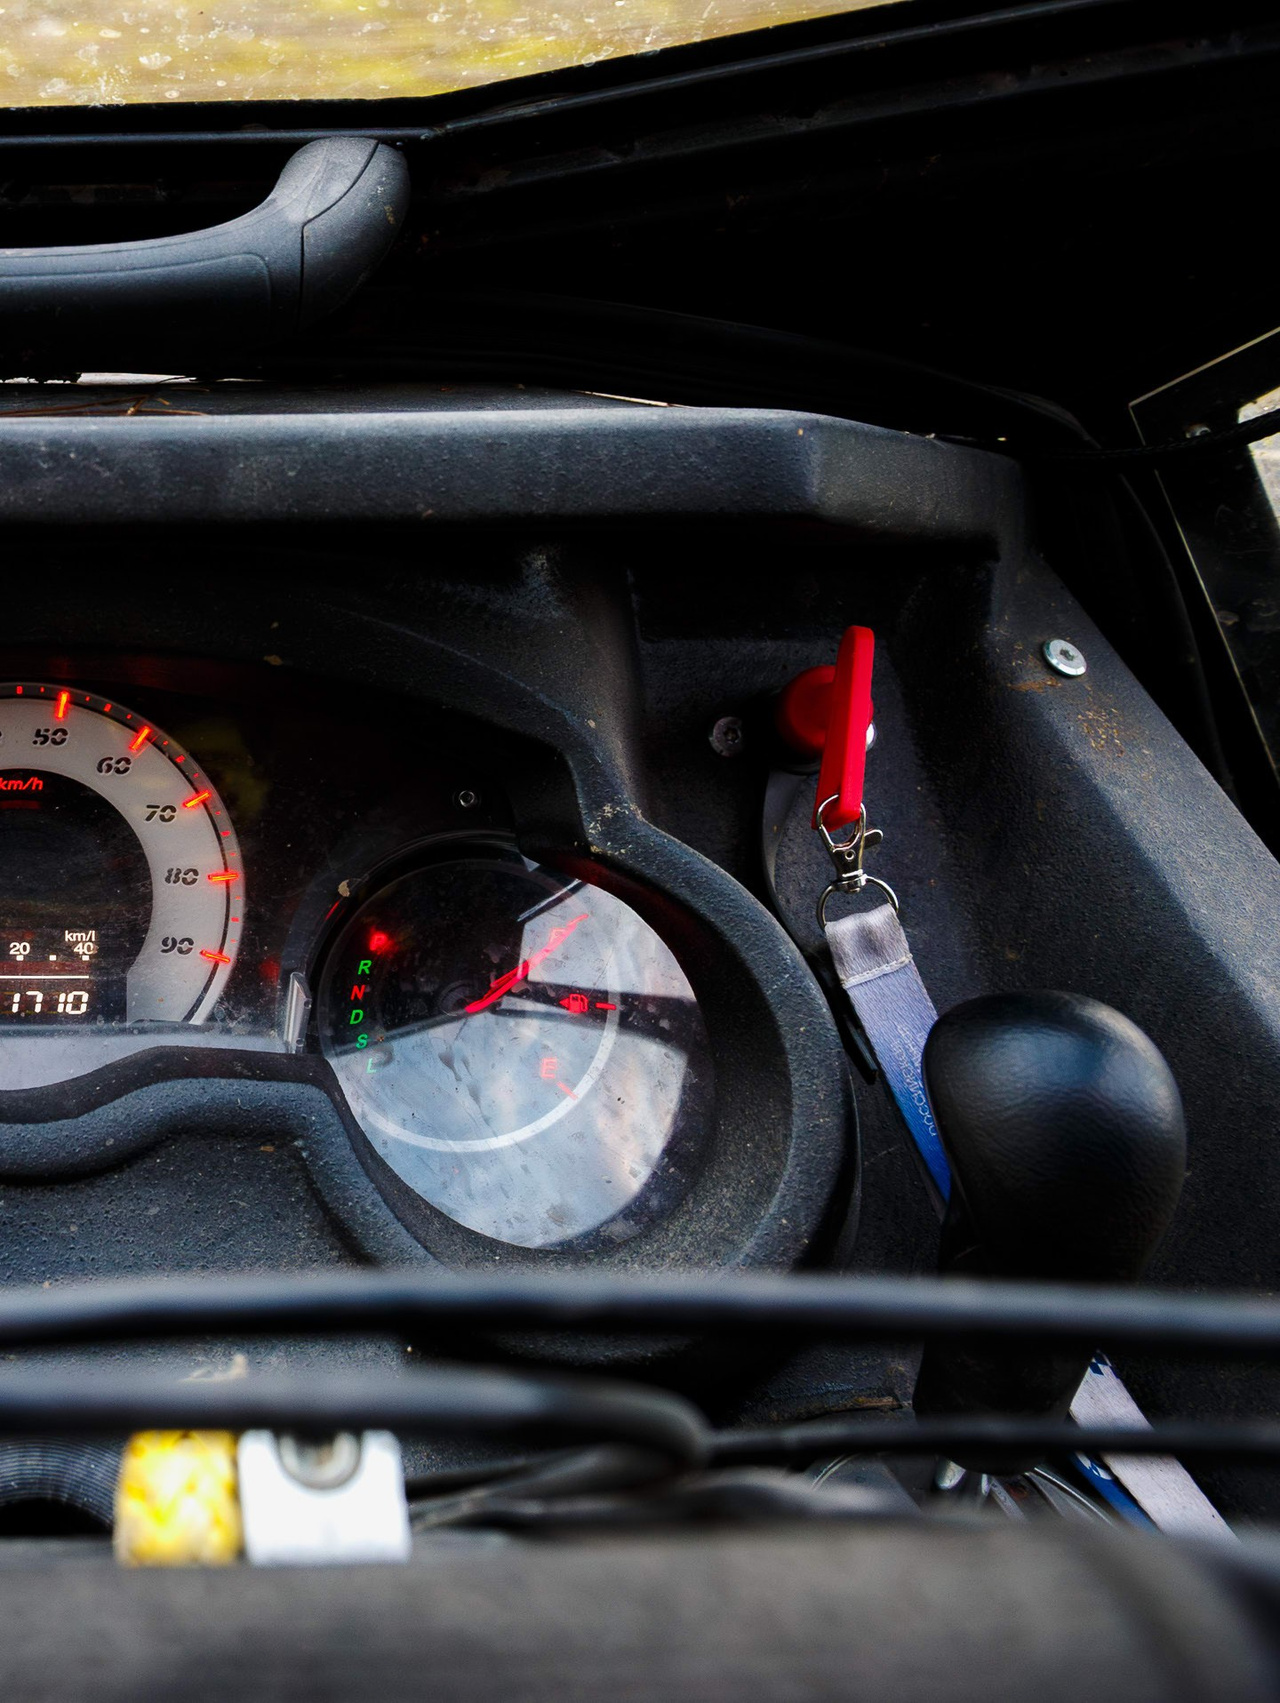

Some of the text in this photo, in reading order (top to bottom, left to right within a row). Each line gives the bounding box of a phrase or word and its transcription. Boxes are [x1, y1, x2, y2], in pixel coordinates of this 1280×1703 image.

[32, 727, 69, 747] 50
[96, 756, 132, 775] 60
[144, 804, 177, 823] 70
[165, 868, 200, 886] 80
[64, 930, 96, 942] km/l
[371, 934, 387, 950] P
[9, 942, 31, 955] 20
[73, 942, 94, 955] 40
[159, 937, 195, 955] 90
[358, 960, 372, 975] R
[350, 984, 366, 1000] N
[349, 1009, 364, 1024] D
[355, 1034, 368, 1049] S
[366, 1057, 377, 1074] L
[540, 1056, 558, 1079] E
